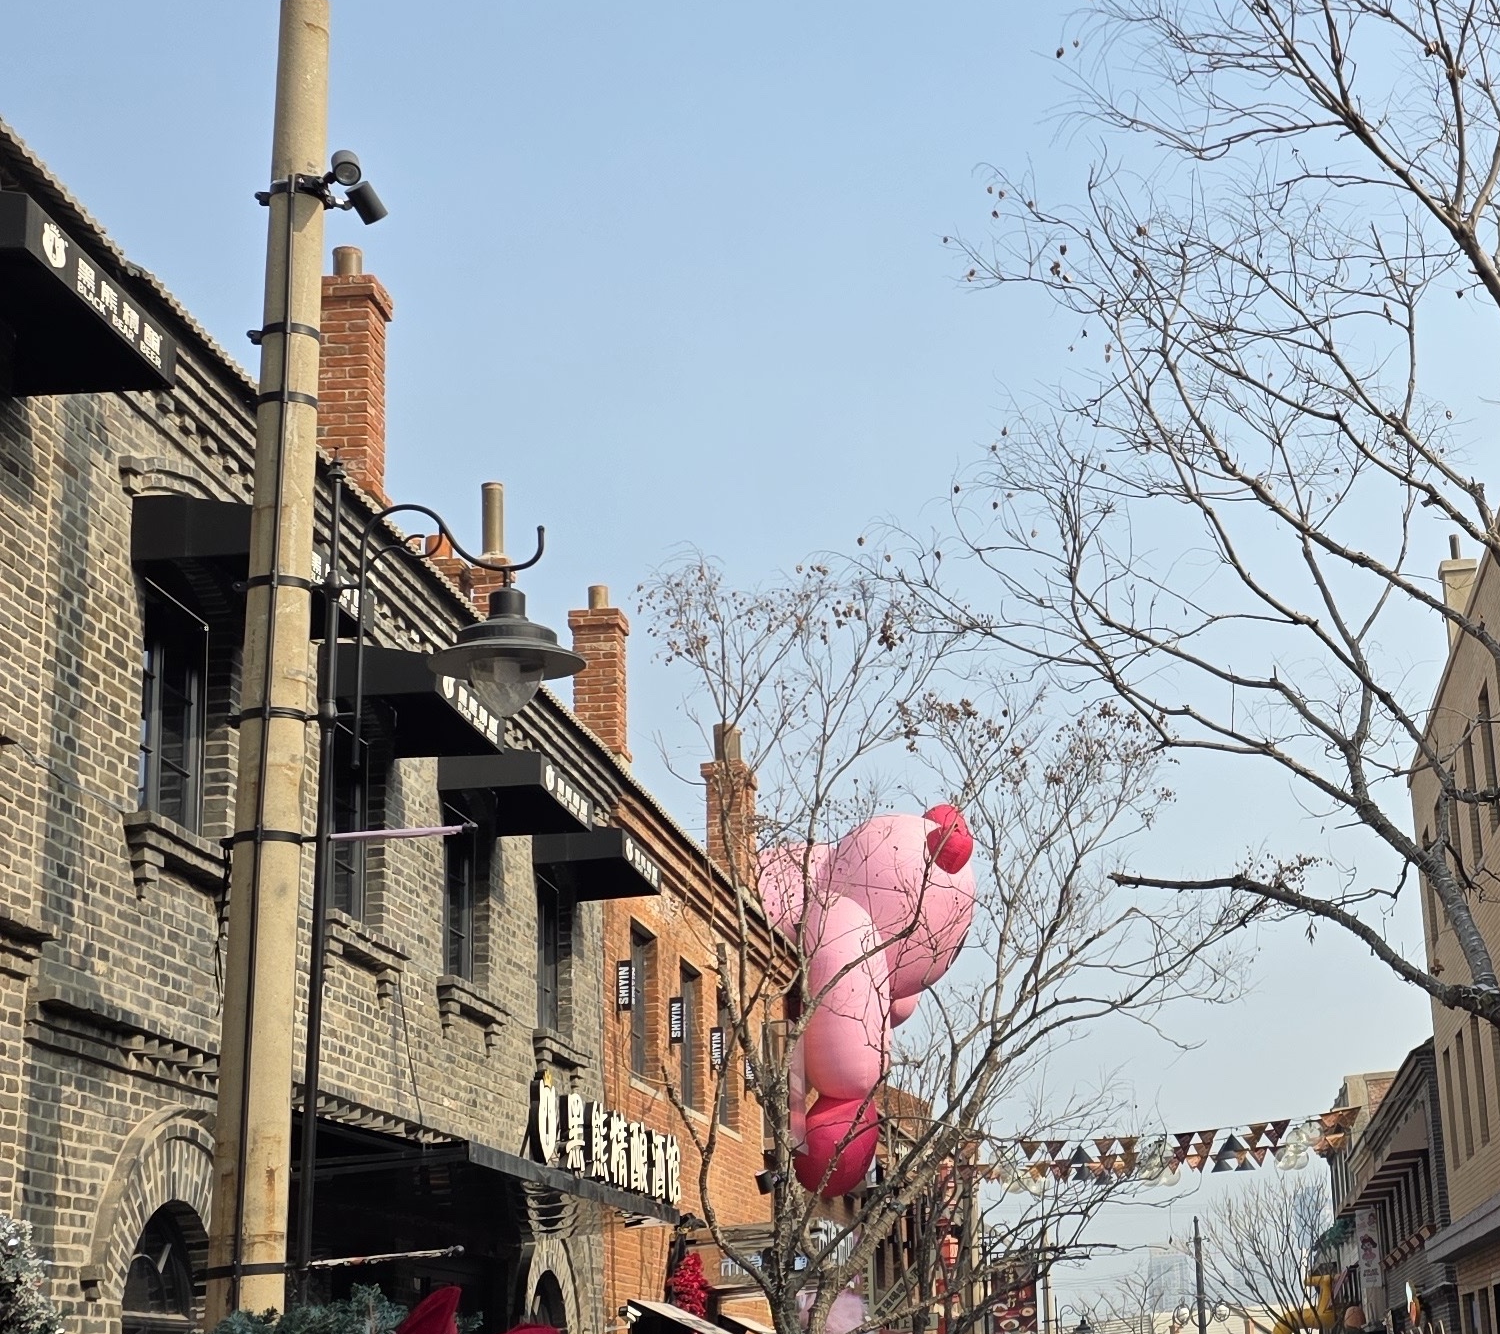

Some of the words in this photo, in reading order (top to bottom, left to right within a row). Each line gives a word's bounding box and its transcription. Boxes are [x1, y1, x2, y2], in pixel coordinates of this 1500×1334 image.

[77, 281, 107, 316] BLACK
[112, 314, 135, 342] BEAR
[140, 340, 162, 369] BEER
[78, 257, 161, 355] 黑熊精酿
[618, 966, 630, 1005] SHIYIN
[671, 1002, 681, 1038] SHIYIN
[566, 1093, 681, 1205] 黑熊精酿酒馆
